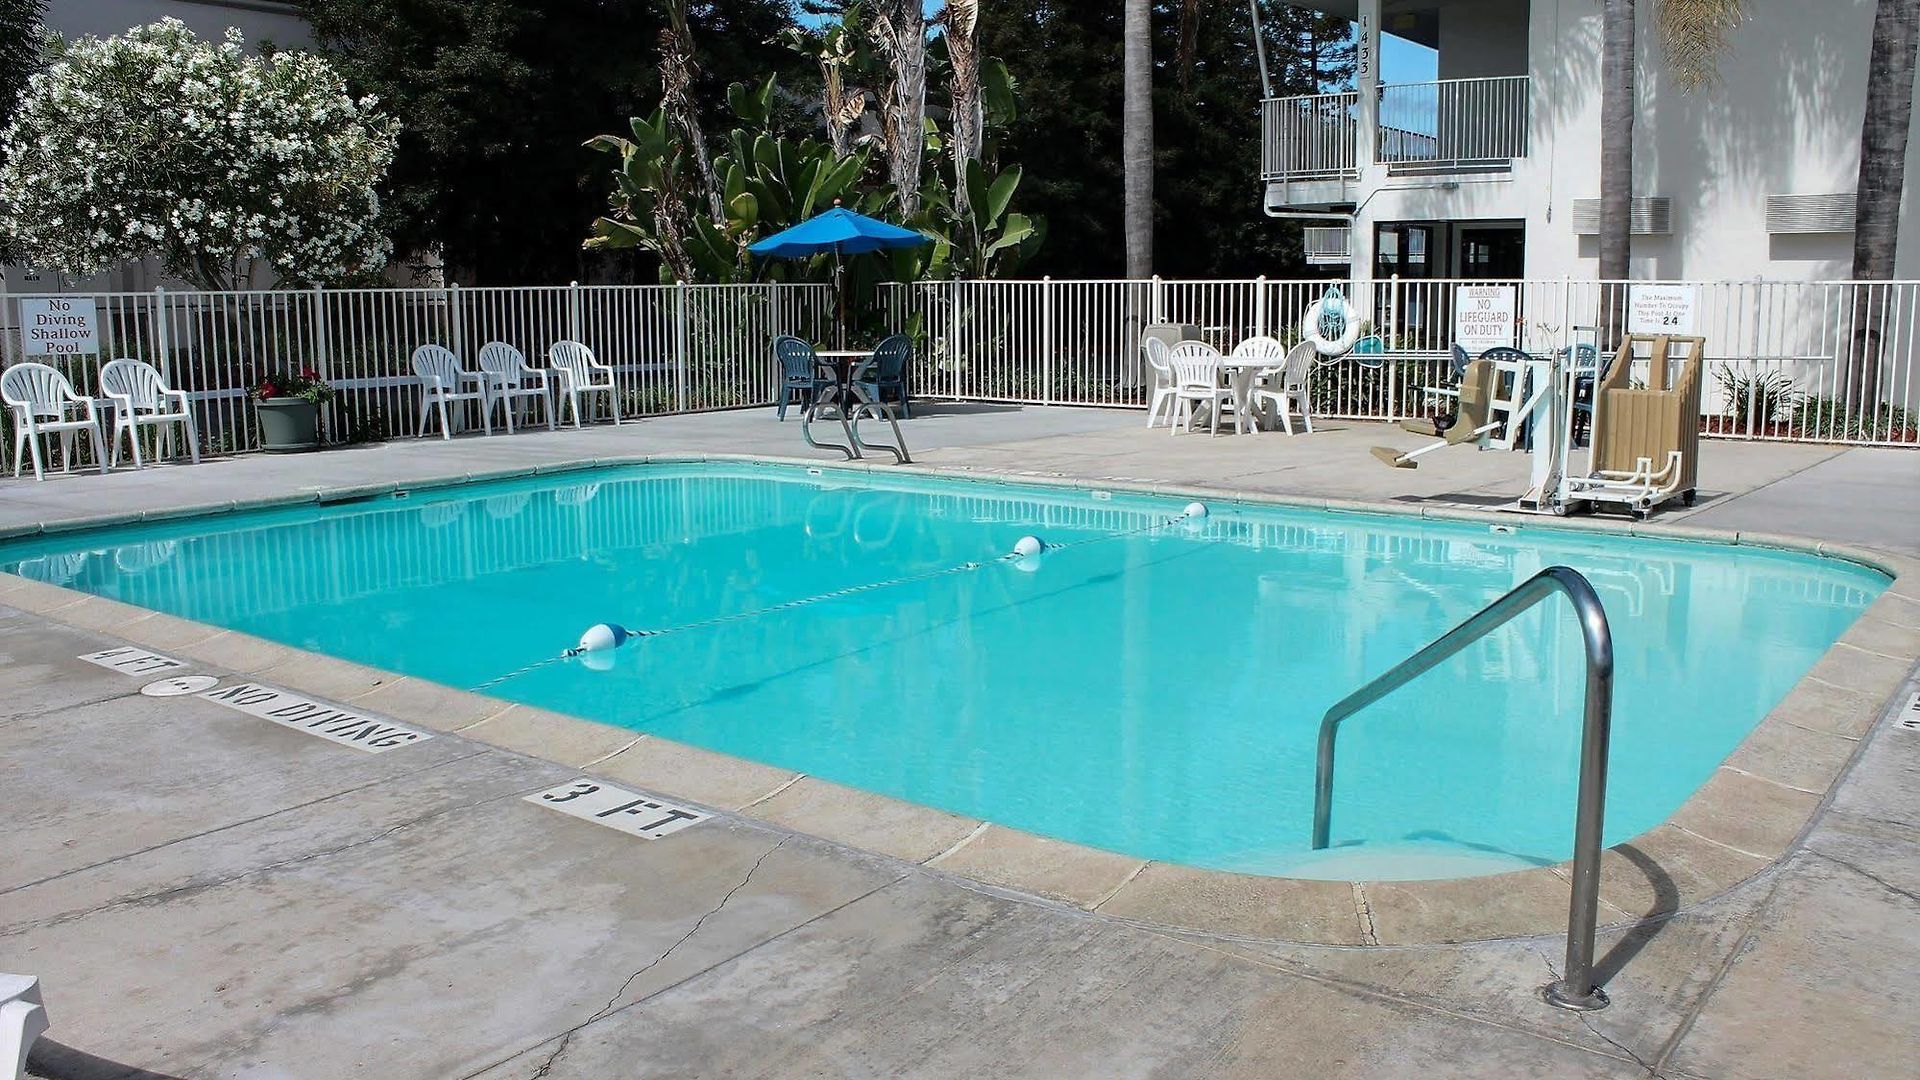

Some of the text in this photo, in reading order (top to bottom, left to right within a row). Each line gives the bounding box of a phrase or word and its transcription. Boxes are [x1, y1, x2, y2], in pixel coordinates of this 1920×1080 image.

[1468, 288, 1500, 296] WARNING
[49, 300, 70, 311] No
[1477, 299, 1491, 310] NO
[36, 314, 86, 326] Diving
[1460, 312, 1508, 322] LIFEGUARD
[1663, 316, 1678, 325] 24
[31, 329, 91, 339] Shallow
[1464, 325, 1502, 335] ON DUTY
[46, 342, 79, 353] Pool
[94, 650, 134, 660] 4
[209, 685, 417, 747] NO DIVING
[542, 783, 600, 802] 3
